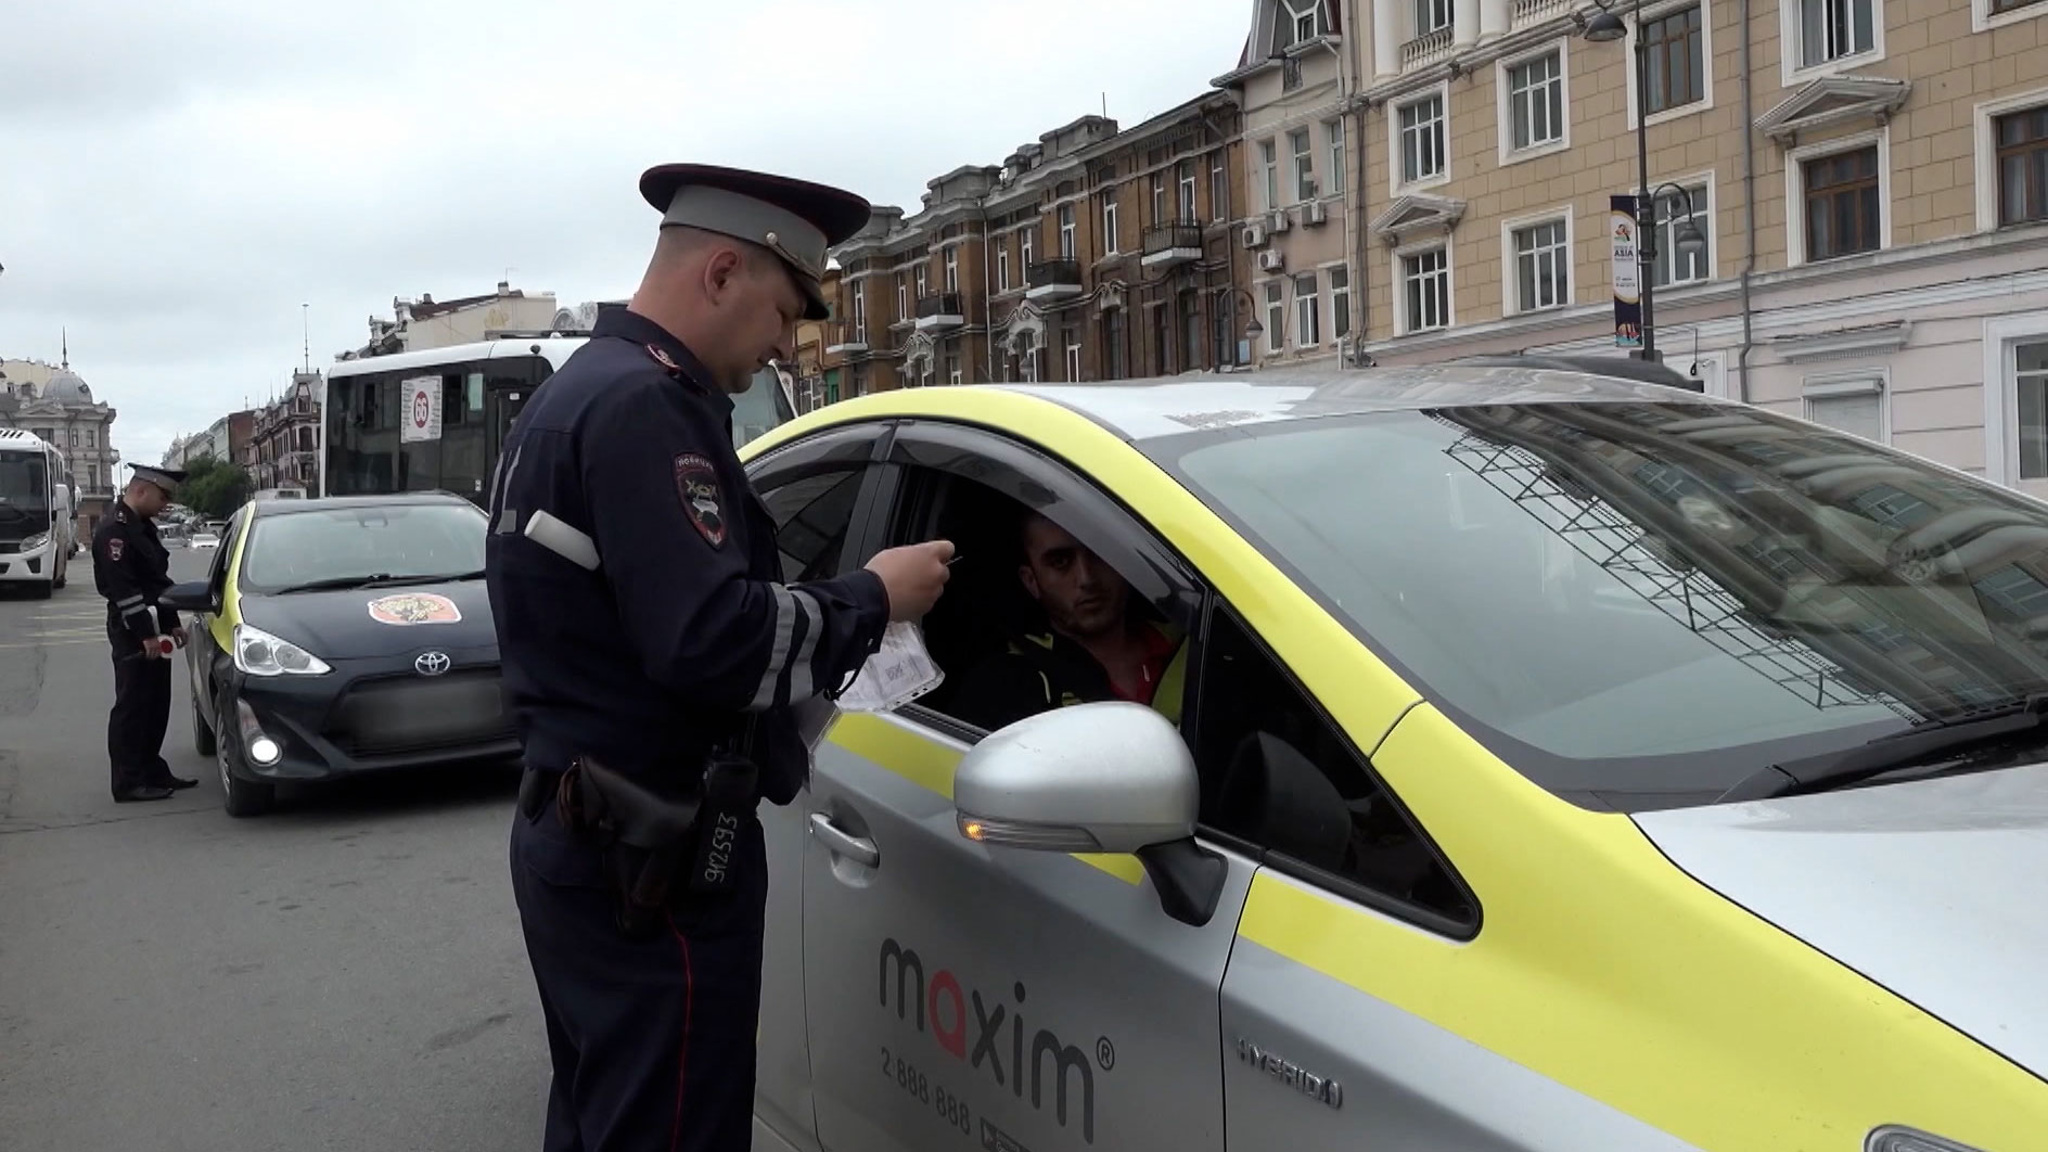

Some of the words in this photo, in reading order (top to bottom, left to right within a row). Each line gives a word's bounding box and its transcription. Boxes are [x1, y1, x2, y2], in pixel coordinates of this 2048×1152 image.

[1614, 249, 1634, 257] ASIA
[880, 1045, 892, 1078] 2
[896, 1057, 929, 1105] 888
[935, 1085, 970, 1136] 888
